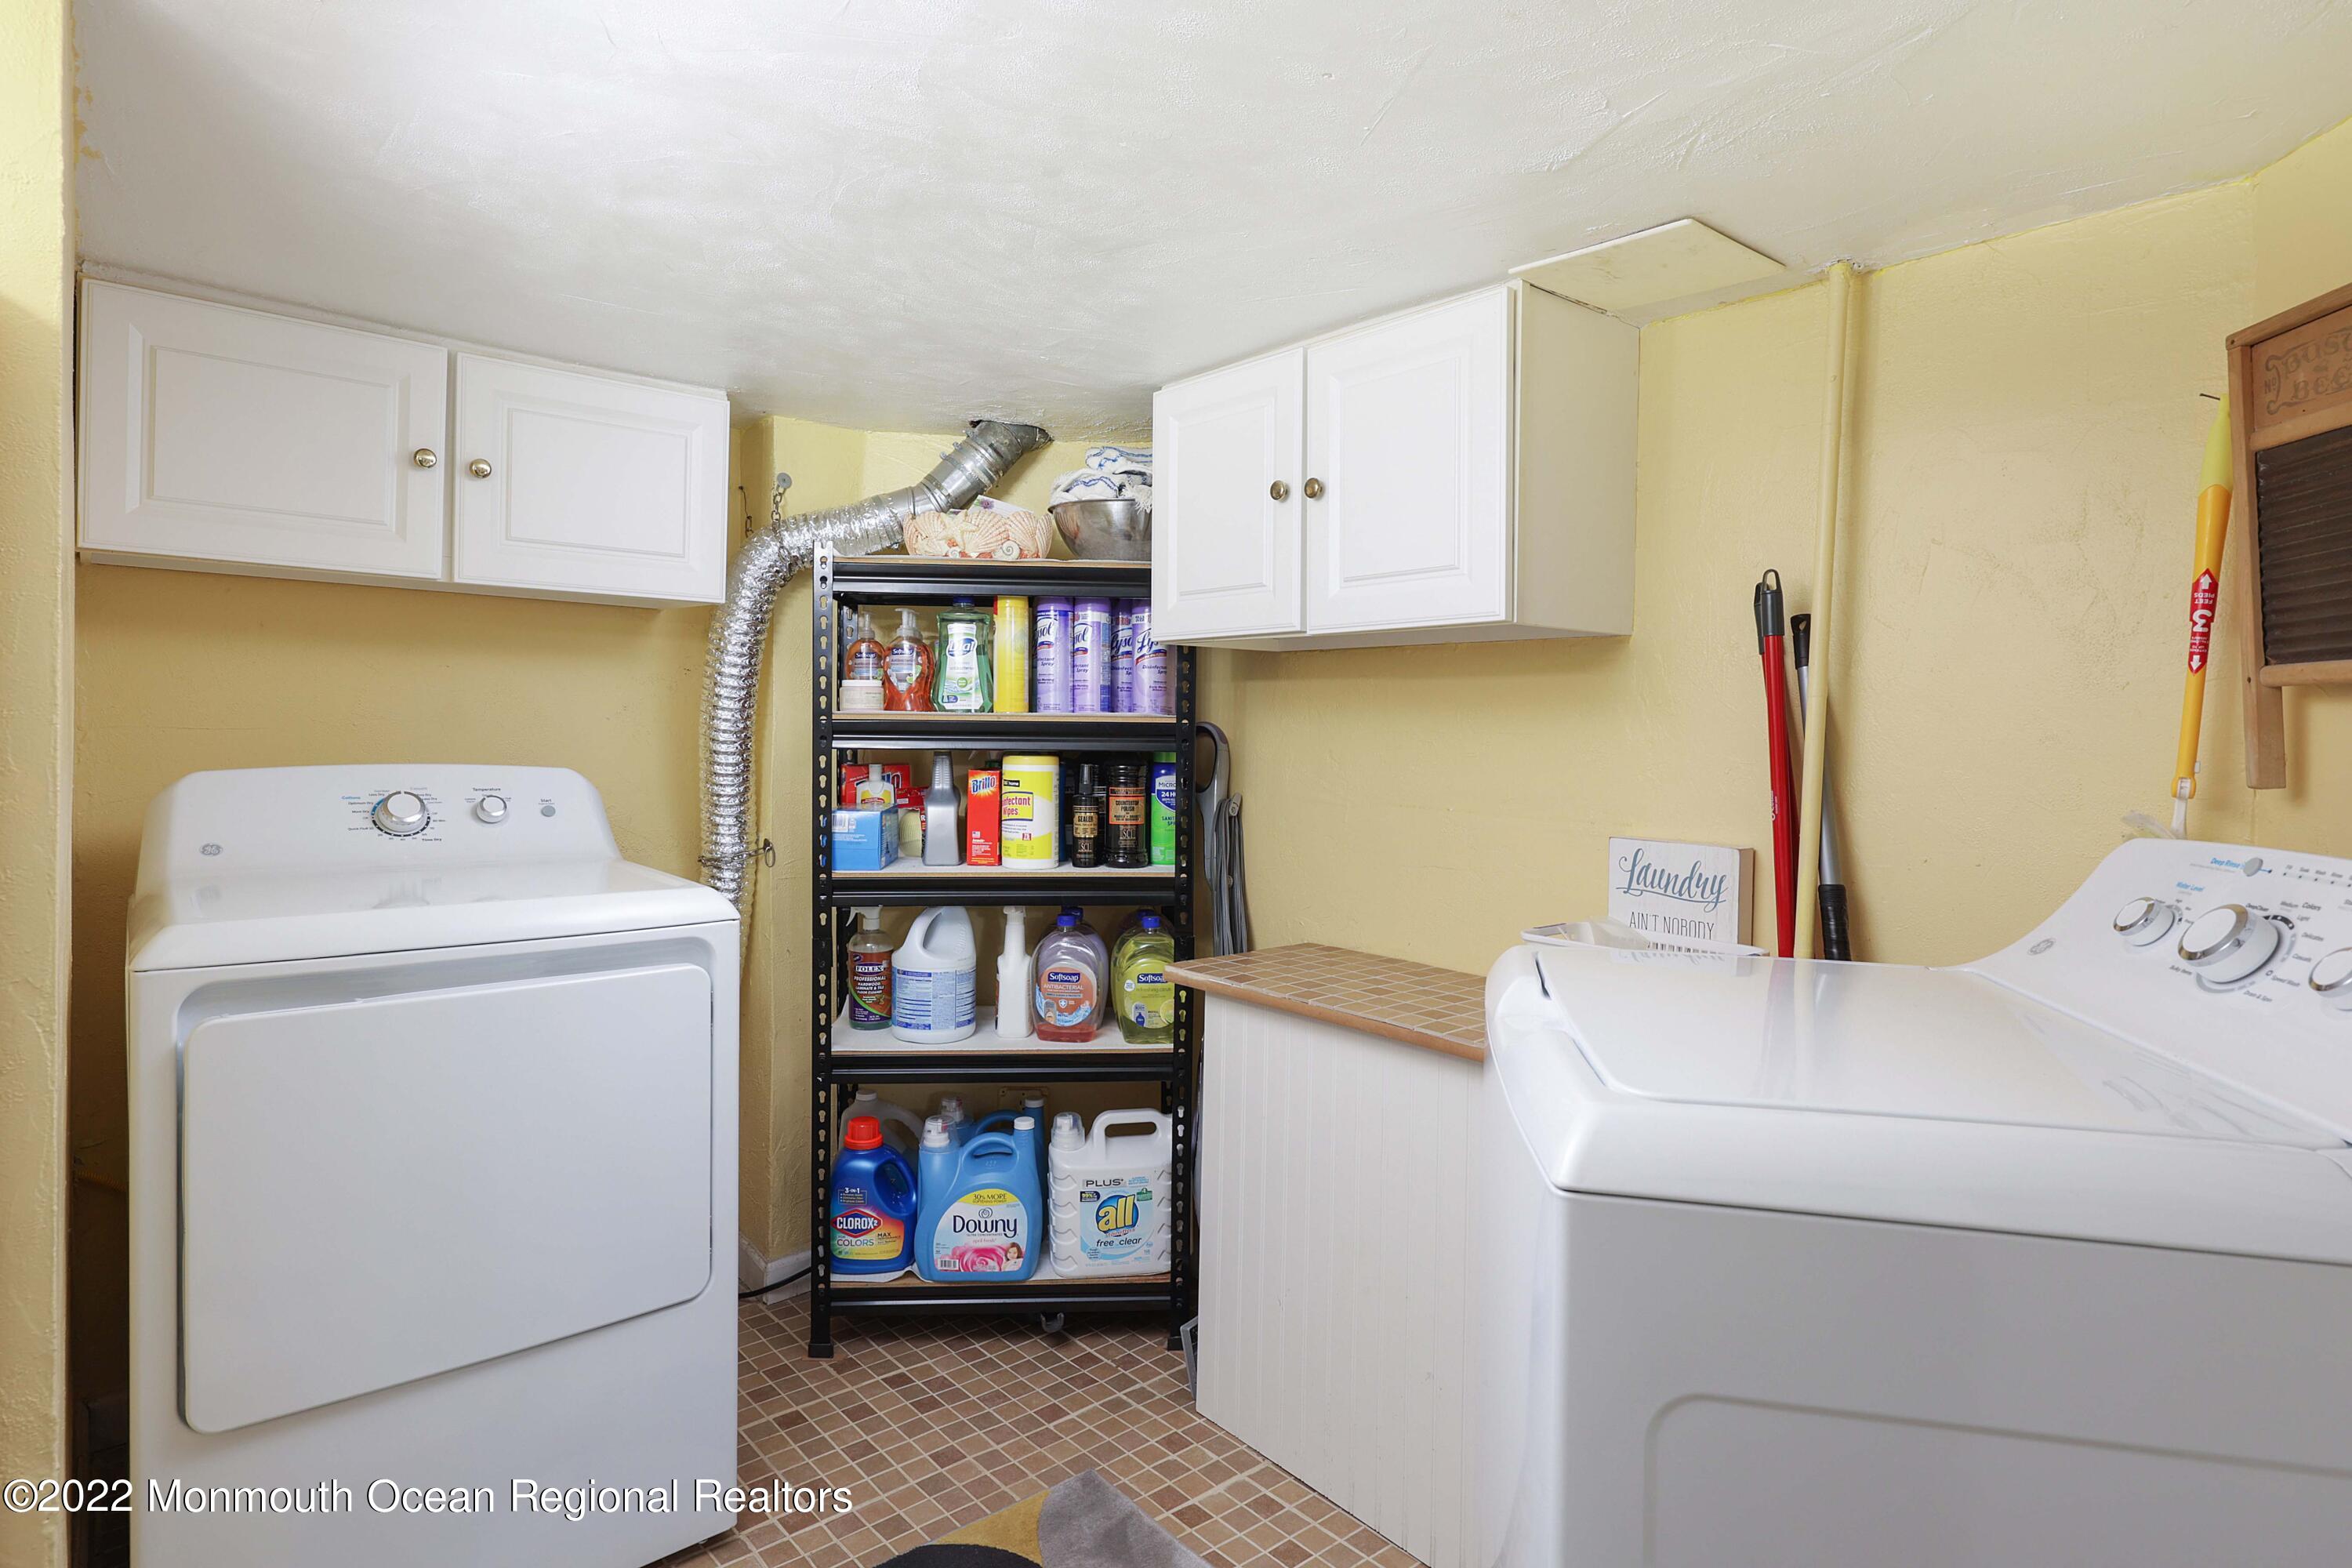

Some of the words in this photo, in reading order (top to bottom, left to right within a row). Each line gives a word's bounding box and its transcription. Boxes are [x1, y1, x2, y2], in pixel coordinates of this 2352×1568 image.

[2192, 609, 2212, 633] 3
[1036, 622, 1052, 639] sol
[1074, 626, 1089, 644] sol
[1111, 633, 1132, 654] Lyso
[1137, 630, 1159, 653] Lys
[972, 776, 996, 793] Brillo
[1002, 796, 1031, 807] nfectant
[1618, 848, 1728, 913] Laundry
[2302, 902, 2321, 911] Colors
[1629, 911, 1660, 931] AIN'T
[1663, 916, 1715, 941] NOBODY
[1049, 972, 1080, 982] Softsoap
[1138, 973, 1167, 983] Softsoa
[1098, 1194, 1136, 1233] all
[953, 1214, 1018, 1239] Downy
[837, 1239, 875, 1247] COLORS
[1096, 1239, 1115, 1247] free
[1119, 1237, 1142, 1246] clear
